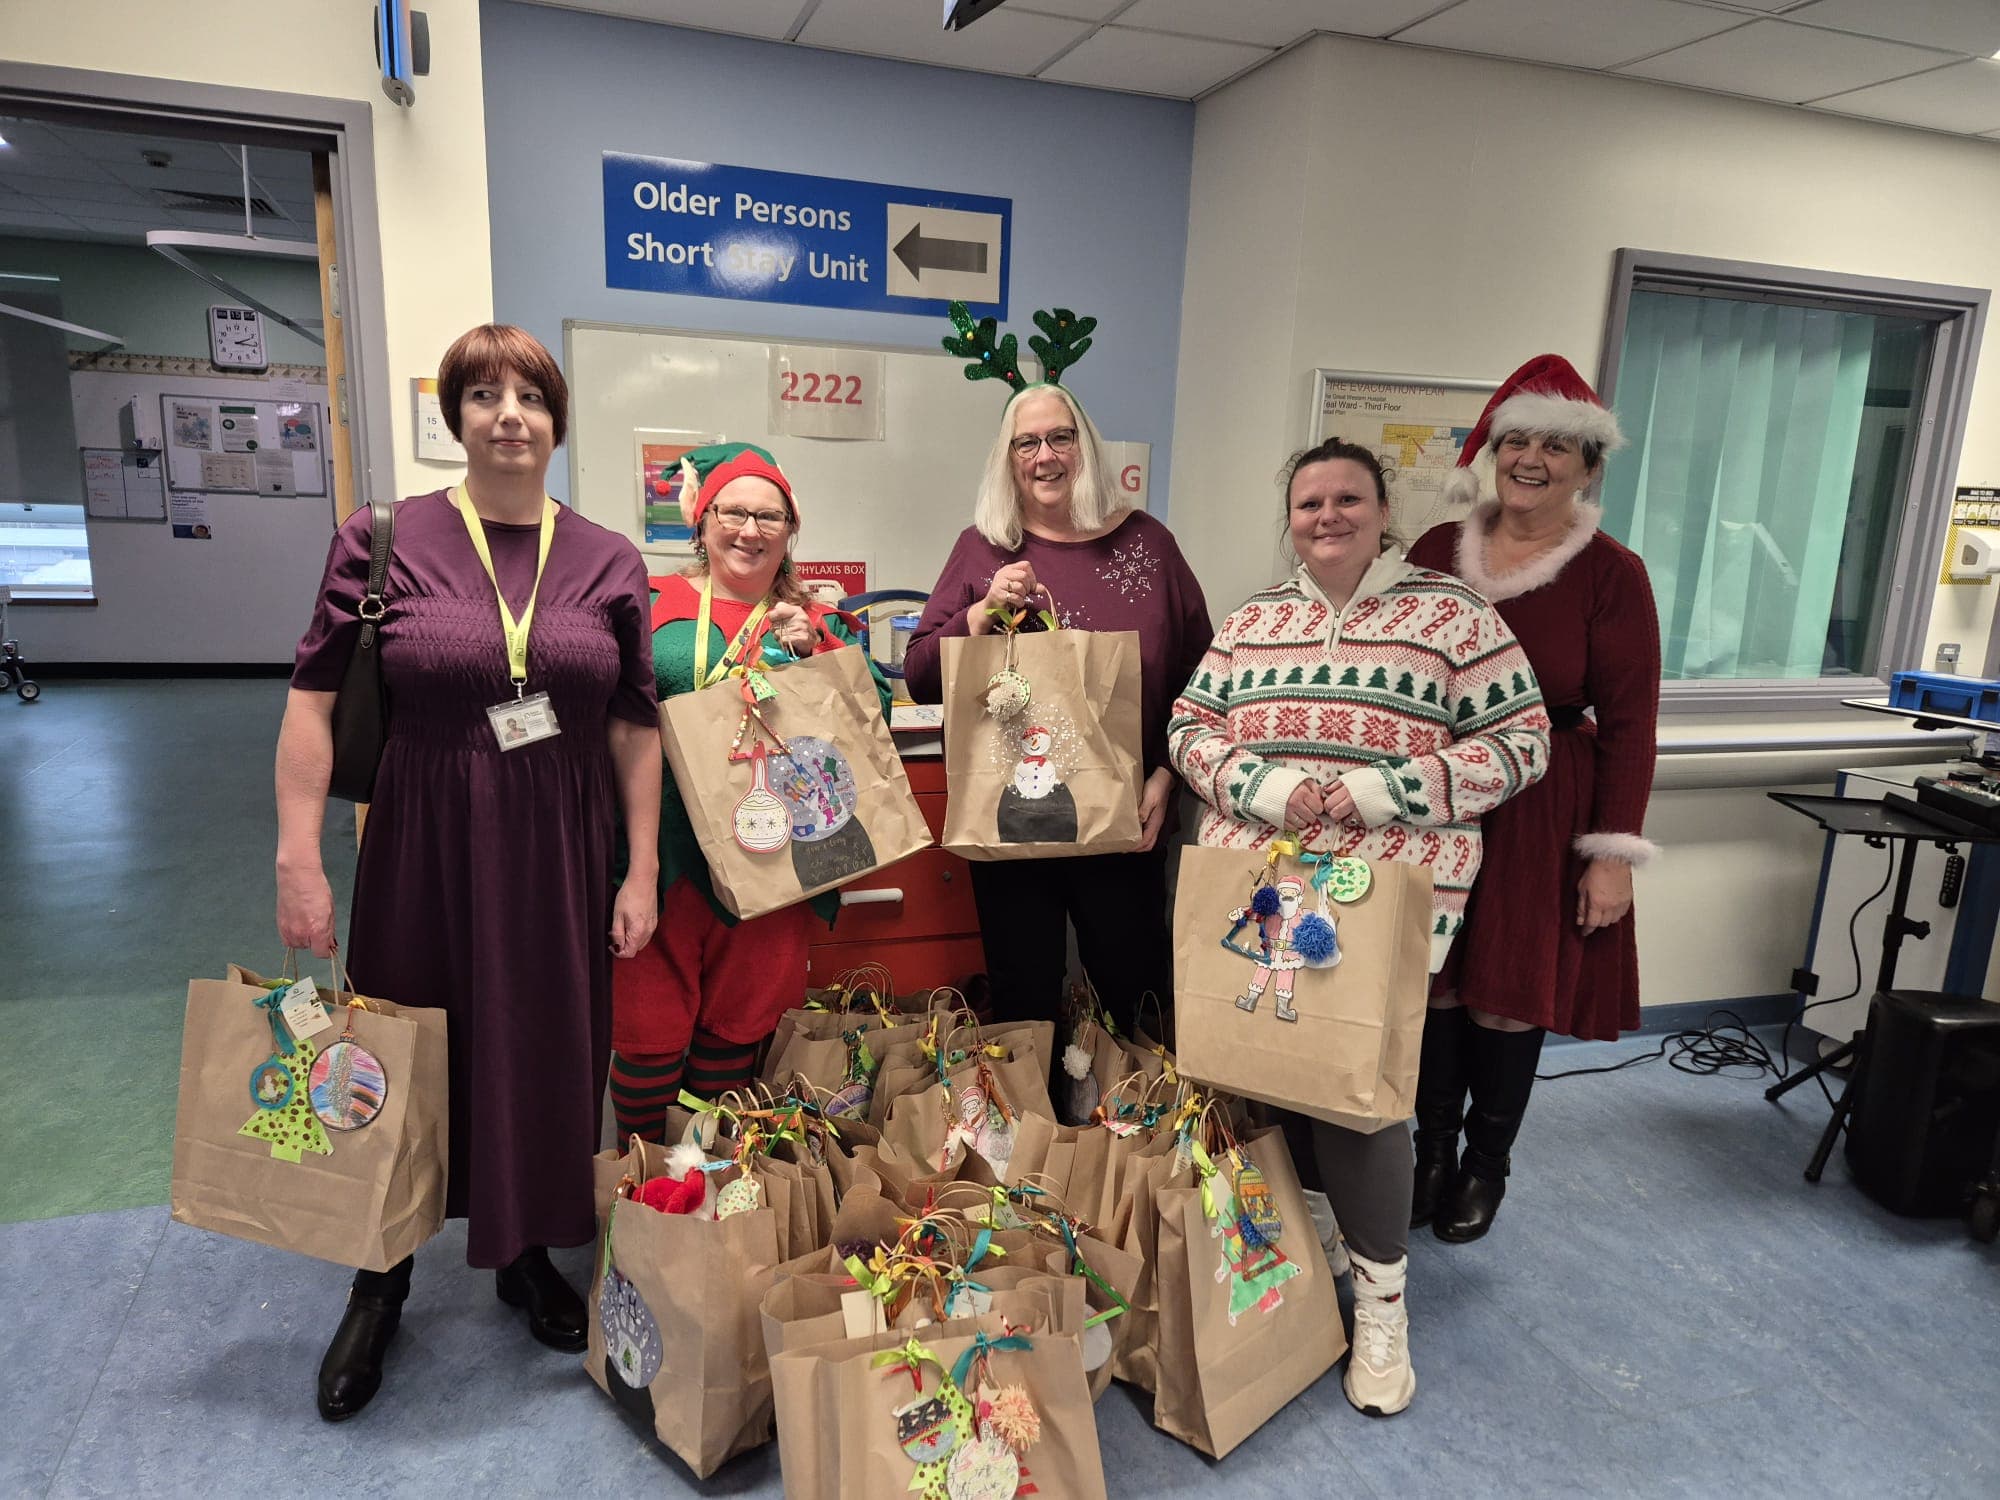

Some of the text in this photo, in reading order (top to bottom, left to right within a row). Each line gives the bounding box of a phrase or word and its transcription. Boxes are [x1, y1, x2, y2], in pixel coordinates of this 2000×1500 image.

[633, 181, 851, 231] Older Persons
[627, 232, 869, 283] Short Stay Unit
[780, 371, 862, 405] 2222
[1338, 400, 1358, 409] Ward
[1365, 402, 1382, 411] Third
[1383, 403, 1401, 411] Floor
[427, 416, 437, 425] 15
[427, 432, 437, 440] 14
[1121, 465, 1141, 492] G
[795, 564, 865, 575] PHYLAXIS BOX
